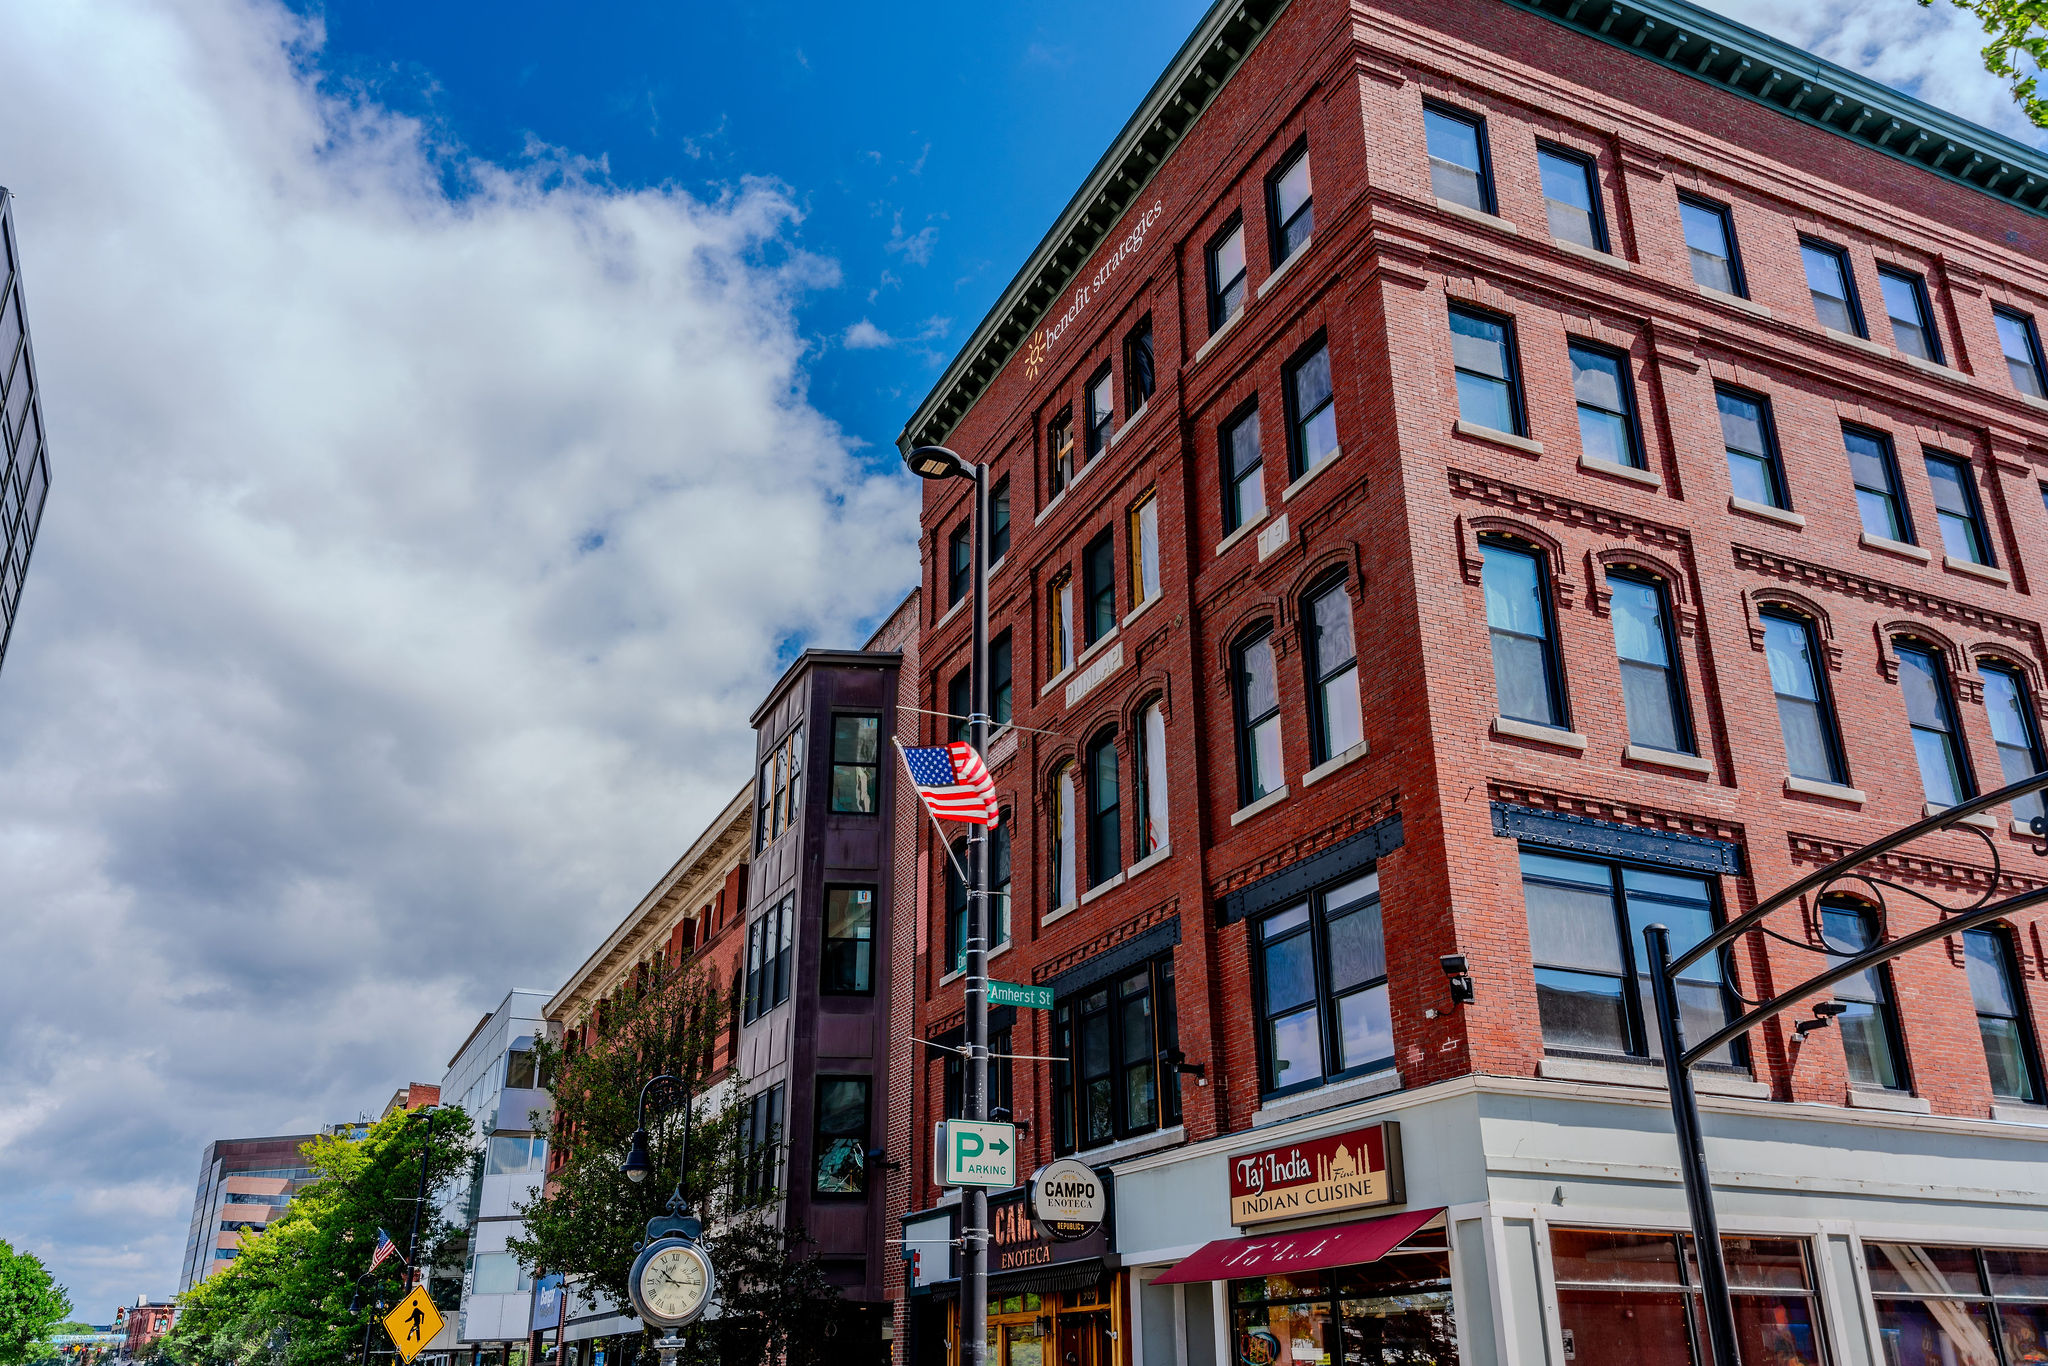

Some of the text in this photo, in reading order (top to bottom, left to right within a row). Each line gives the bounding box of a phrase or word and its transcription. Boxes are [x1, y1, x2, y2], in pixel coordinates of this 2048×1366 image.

[1045, 199, 1162, 352] benefit strategies
[1065, 648, 1121, 706] DUNLAP
[990, 985, 1051, 1006] Amherst St
[1236, 1148, 1312, 1197] Taj India
[1332, 1167, 1355, 1182] Fine
[1045, 1181, 1095, 1199] CAMPO
[1048, 1198, 1093, 1209] ENOTECA
[1242, 1179, 1373, 1215] INDIAN CUISINE
[995, 1202, 1039, 1247] CAM
[1001, 1245, 1051, 1270] ENOTECA
